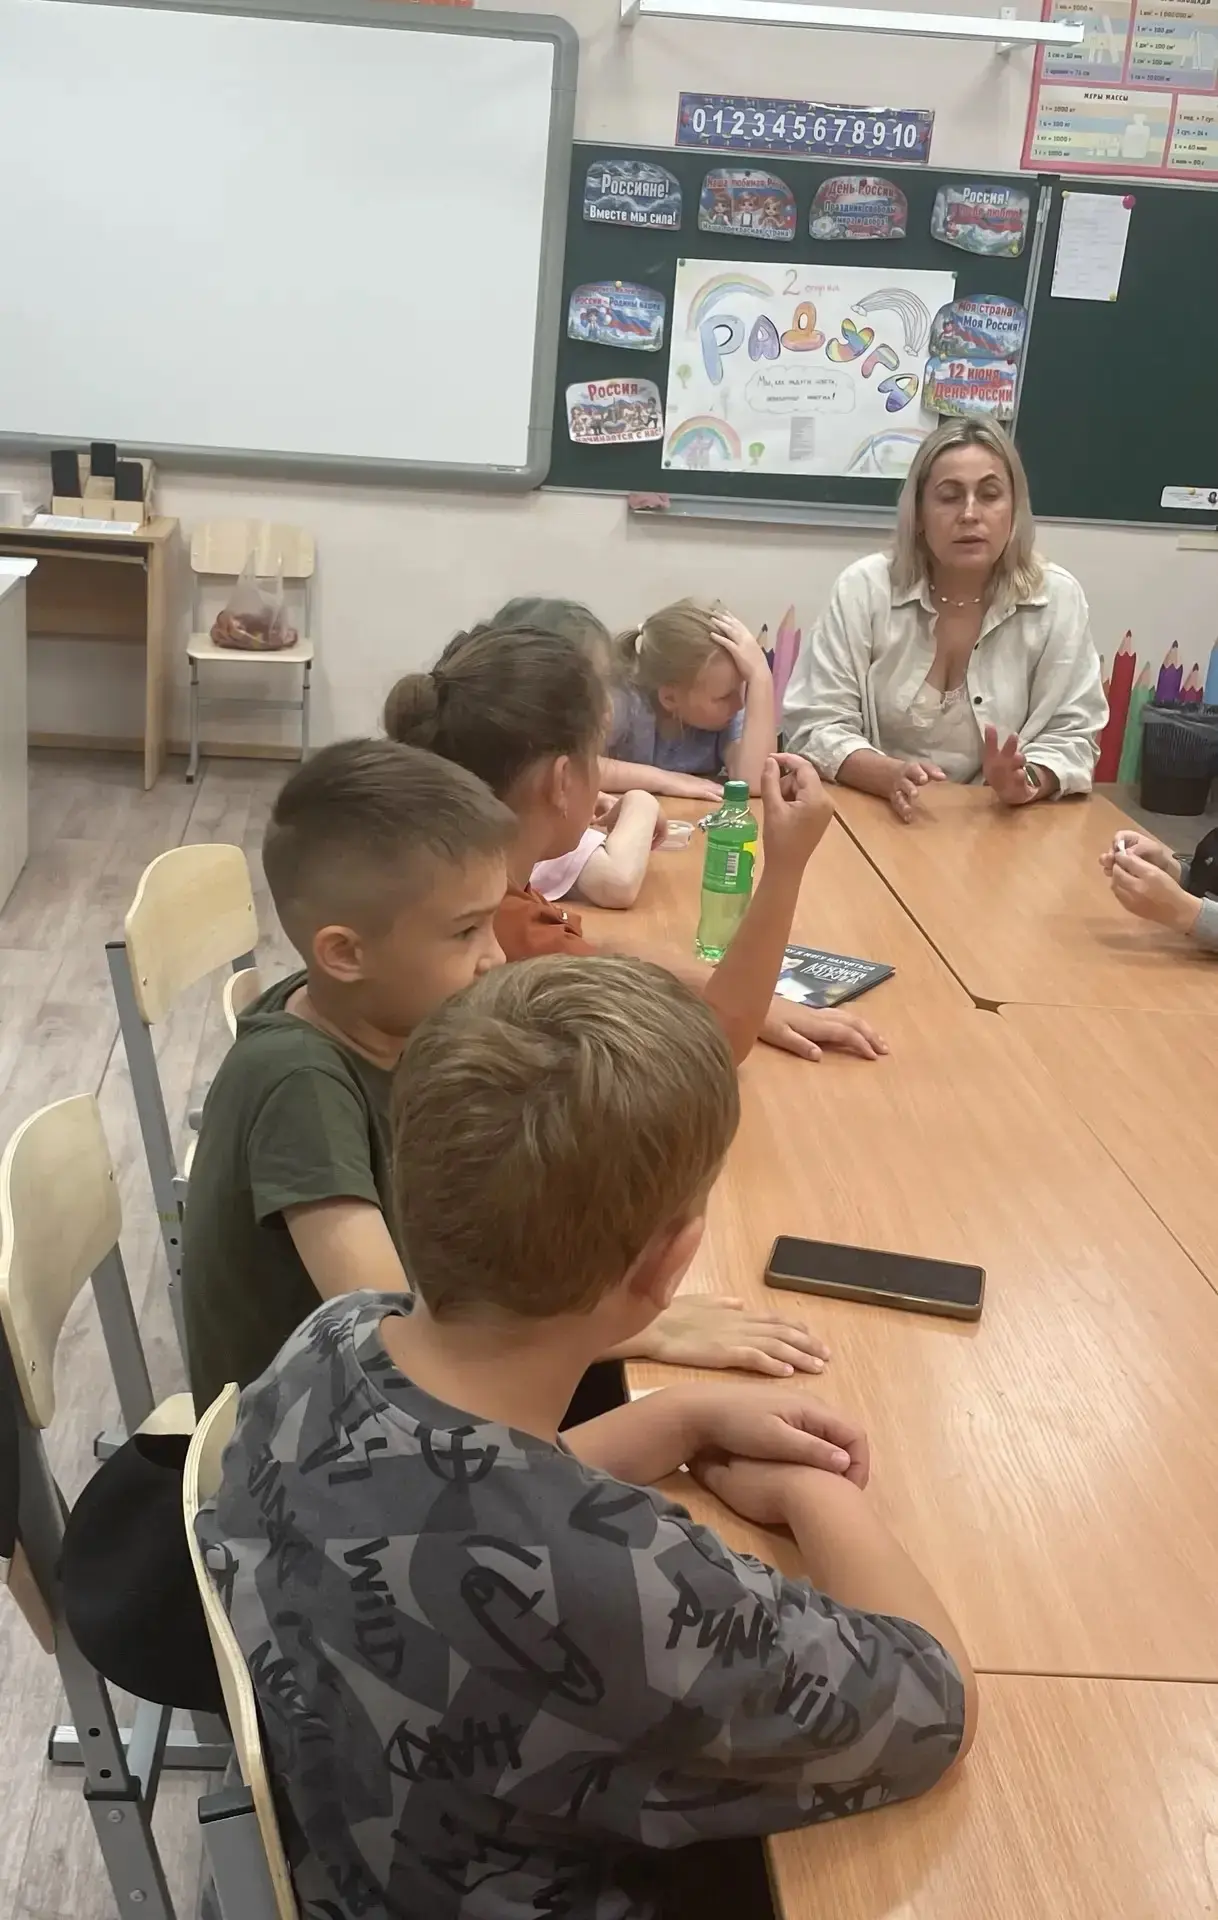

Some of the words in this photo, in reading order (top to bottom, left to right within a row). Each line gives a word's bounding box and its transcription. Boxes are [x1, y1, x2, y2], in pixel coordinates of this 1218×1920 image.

[693, 108, 706, 132] 0
[713, 110, 723, 134] 1
[730, 111, 745, 135] 2
[752, 112, 765, 136] 3
[772, 114, 786, 138] 4
[792, 116, 807, 140] 5
[814, 118, 827, 142] 6
[834, 119, 847, 142] 7
[852, 120, 866, 144] 8
[873, 122, 886, 145] 9
[892, 123, 916, 148] 10
[601, 174, 670, 198] Россияне!
[827, 181, 855, 198] День
[858, 182, 894, 197] России
[963, 188, 1010, 205] Россия!
[590, 205, 627, 220] Вместе
[630, 212, 647, 222] мы
[650, 211, 676, 225] сила!
[783, 268, 800, 296] 2
[957, 302, 976, 313] Моя
[979, 304, 1016, 316] страна!
[963, 316, 982, 328] Моя
[986, 318, 1022, 332] Россия!
[949, 363, 965, 379] 12
[968, 367, 1000, 381] июня
[588, 384, 638, 401] Россия
[933, 383, 969, 401] День
[970, 385, 1012, 401] России
